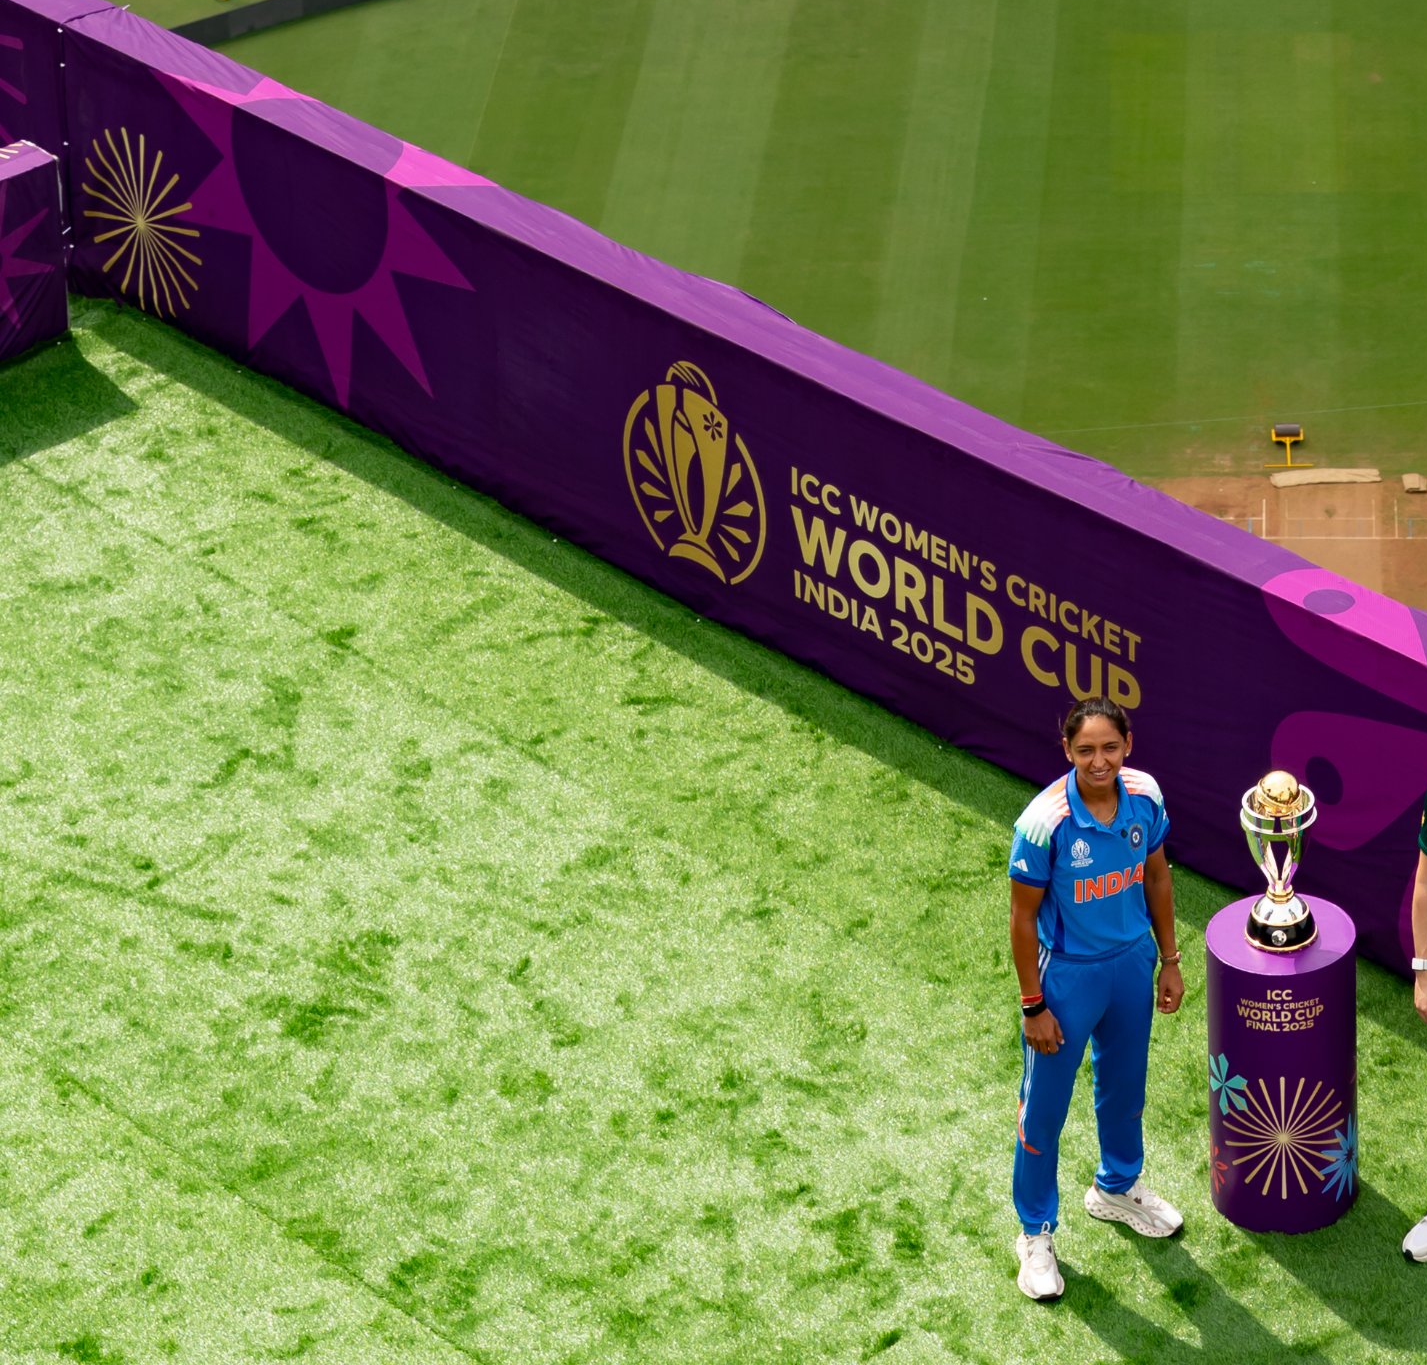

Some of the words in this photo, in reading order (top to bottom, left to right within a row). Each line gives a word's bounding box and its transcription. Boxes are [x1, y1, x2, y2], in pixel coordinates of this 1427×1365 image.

[791, 466, 842, 516] ICC
[849, 494, 997, 593] WOMEN'S
[1006, 574, 1142, 663] CRICKET
[790, 504, 1004, 655] WORLD
[1020, 625, 1142, 710] CUP
[793, 569, 884, 641] INDIA
[890, 620, 976, 685] 2025
[1074, 861, 1144, 903] INDIA
[1240, 998, 1281, 1010] WOMEN'S
[1283, 997, 1320, 1009] CRICKET
[1266, 989, 1293, 1000] ICC
[1236, 1004, 1292, 1022] WORLD
[1294, 1005, 1324, 1021] CUP
[1246, 1019, 1280, 1032] FINAL
[1282, 1019, 1314, 1032] 2025
